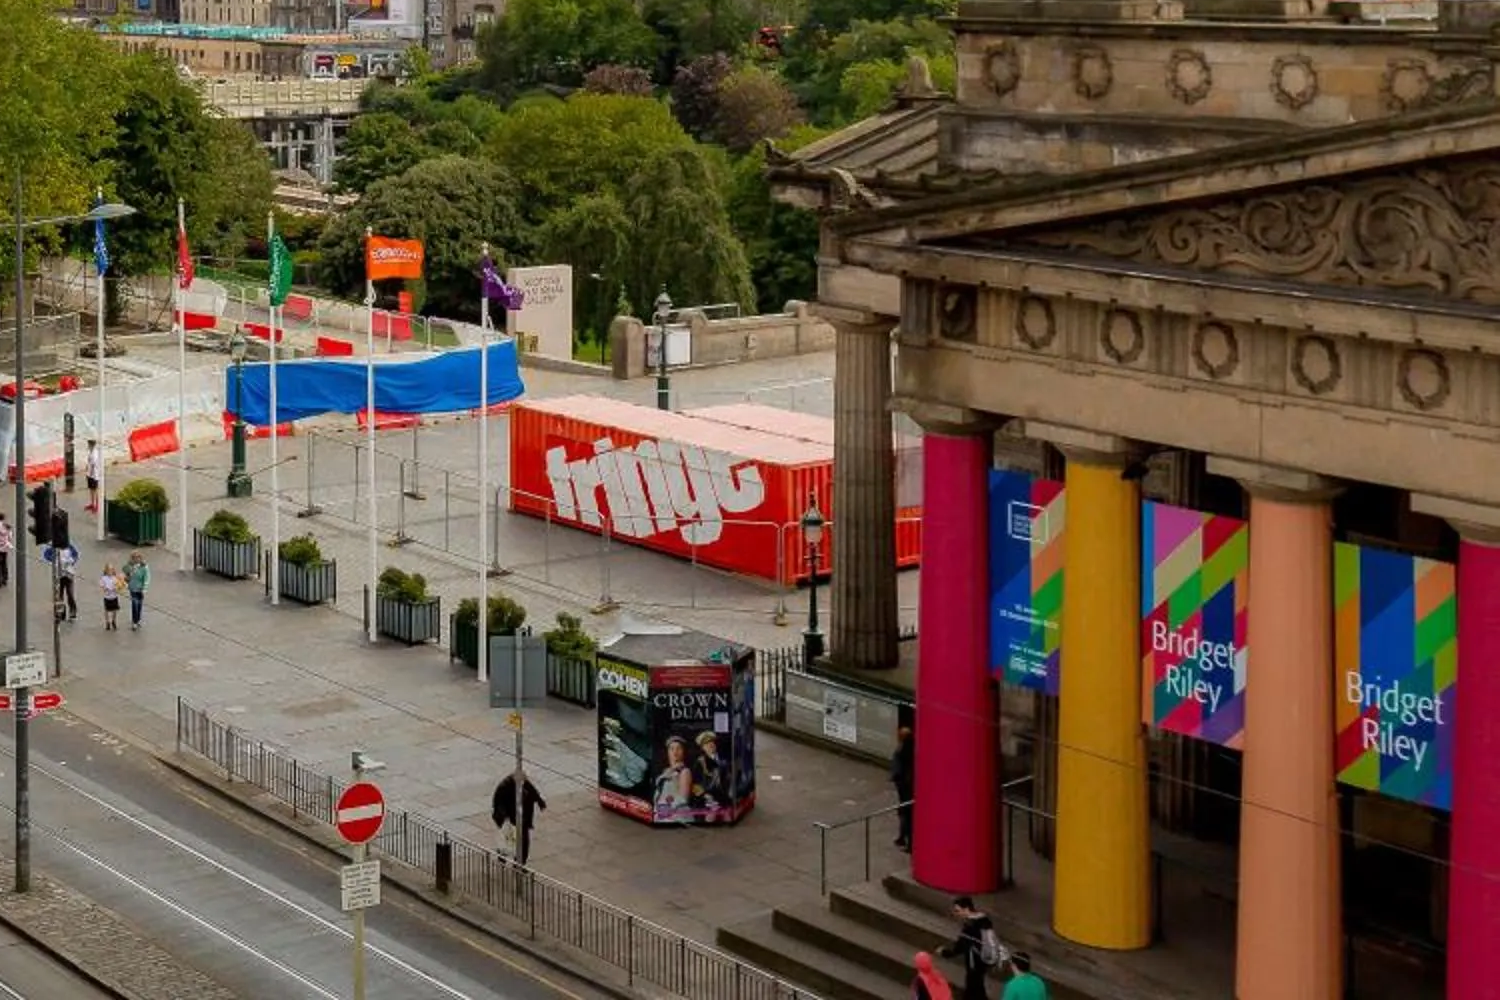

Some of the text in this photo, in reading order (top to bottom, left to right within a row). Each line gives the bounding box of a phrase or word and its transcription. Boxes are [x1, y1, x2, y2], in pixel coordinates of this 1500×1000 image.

[1152, 620, 1237, 672] Bridget
[598, 667, 649, 699] COHEN
[653, 692, 729, 708] CROWN
[1165, 663, 1222, 713] Riley
[1346, 671, 1445, 726] Bridget
[671, 707, 713, 720] DUAL
[1363, 717, 1428, 772] Riley
